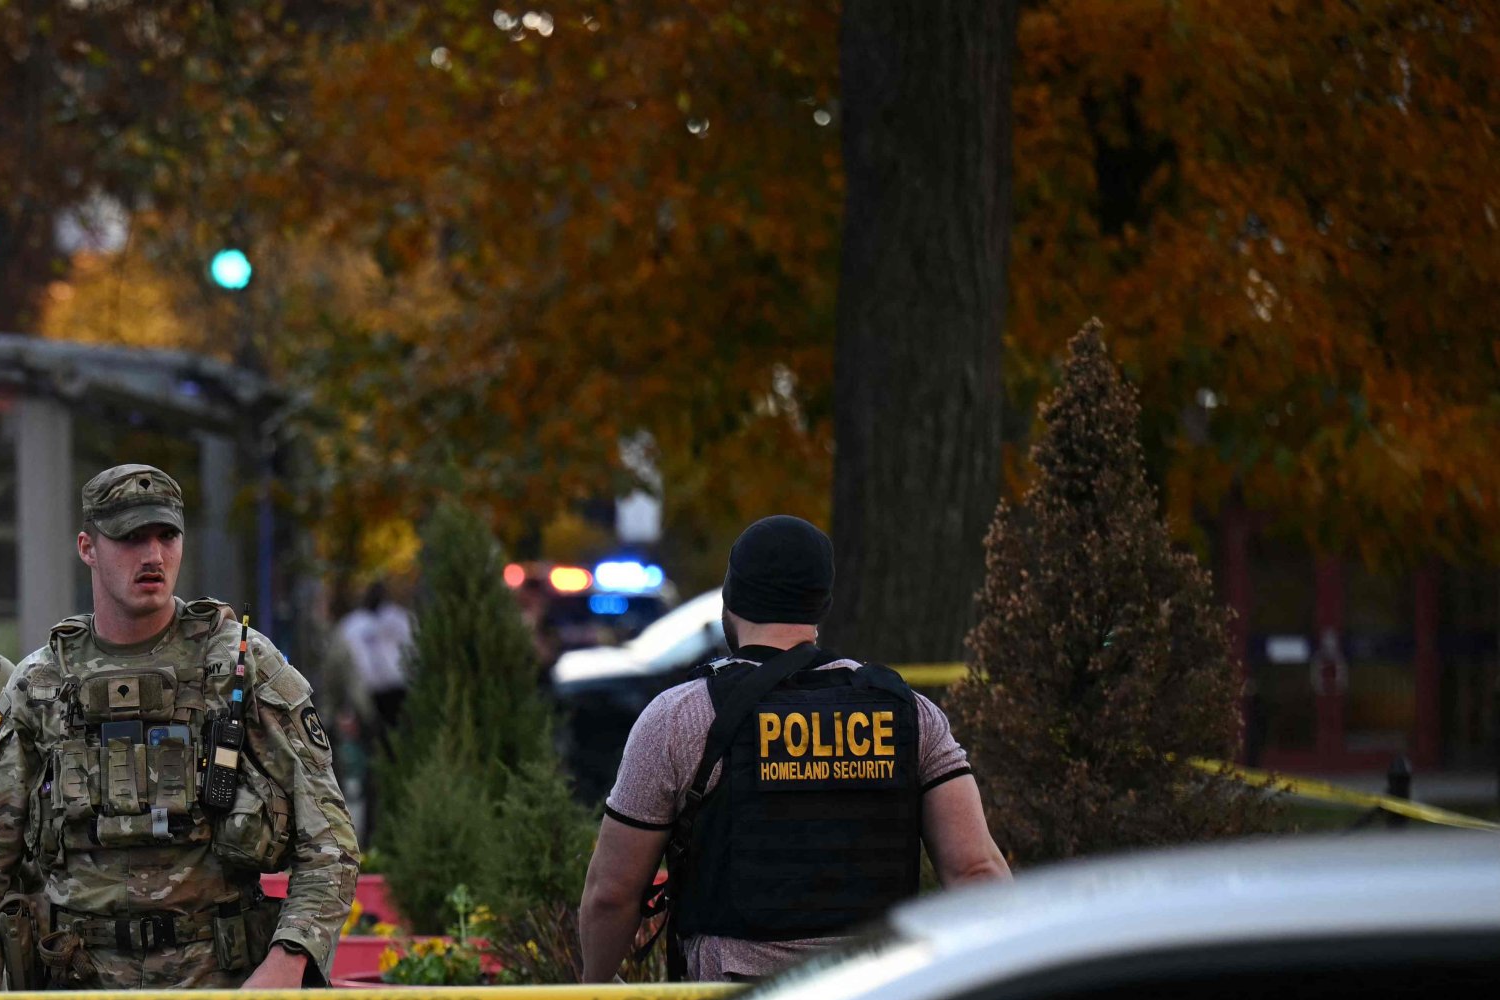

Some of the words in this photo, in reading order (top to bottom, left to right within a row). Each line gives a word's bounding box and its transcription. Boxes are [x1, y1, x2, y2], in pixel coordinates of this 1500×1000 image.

[759, 711, 895, 758] POLICE
[761, 761, 830, 780] HOMELAND
[833, 760, 895, 779] SECURITY
